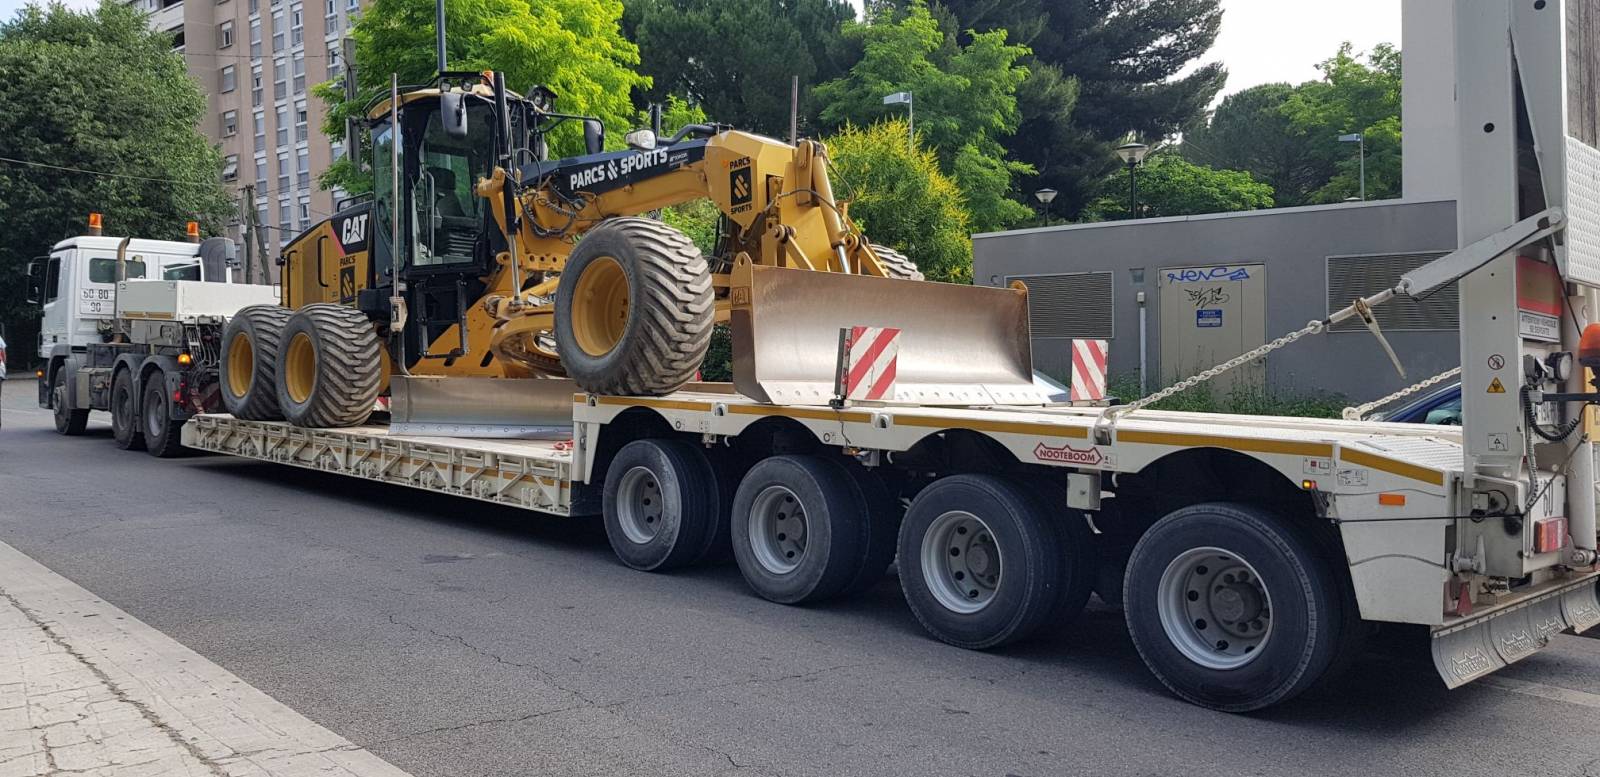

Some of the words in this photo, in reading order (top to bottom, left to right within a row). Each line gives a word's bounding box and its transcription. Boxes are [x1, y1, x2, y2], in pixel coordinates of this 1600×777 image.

[570, 164, 605, 190] PARCS
[620, 146, 669, 175] SPORTS
[730, 156, 750, 169] PARCS
[731, 203, 752, 215] SPORTS
[342, 214, 368, 245] CAT
[340, 256, 355, 267] PARCS
[98, 289, 109, 300] 80
[1040, 449, 1095, 462] NOOTEBOOM
